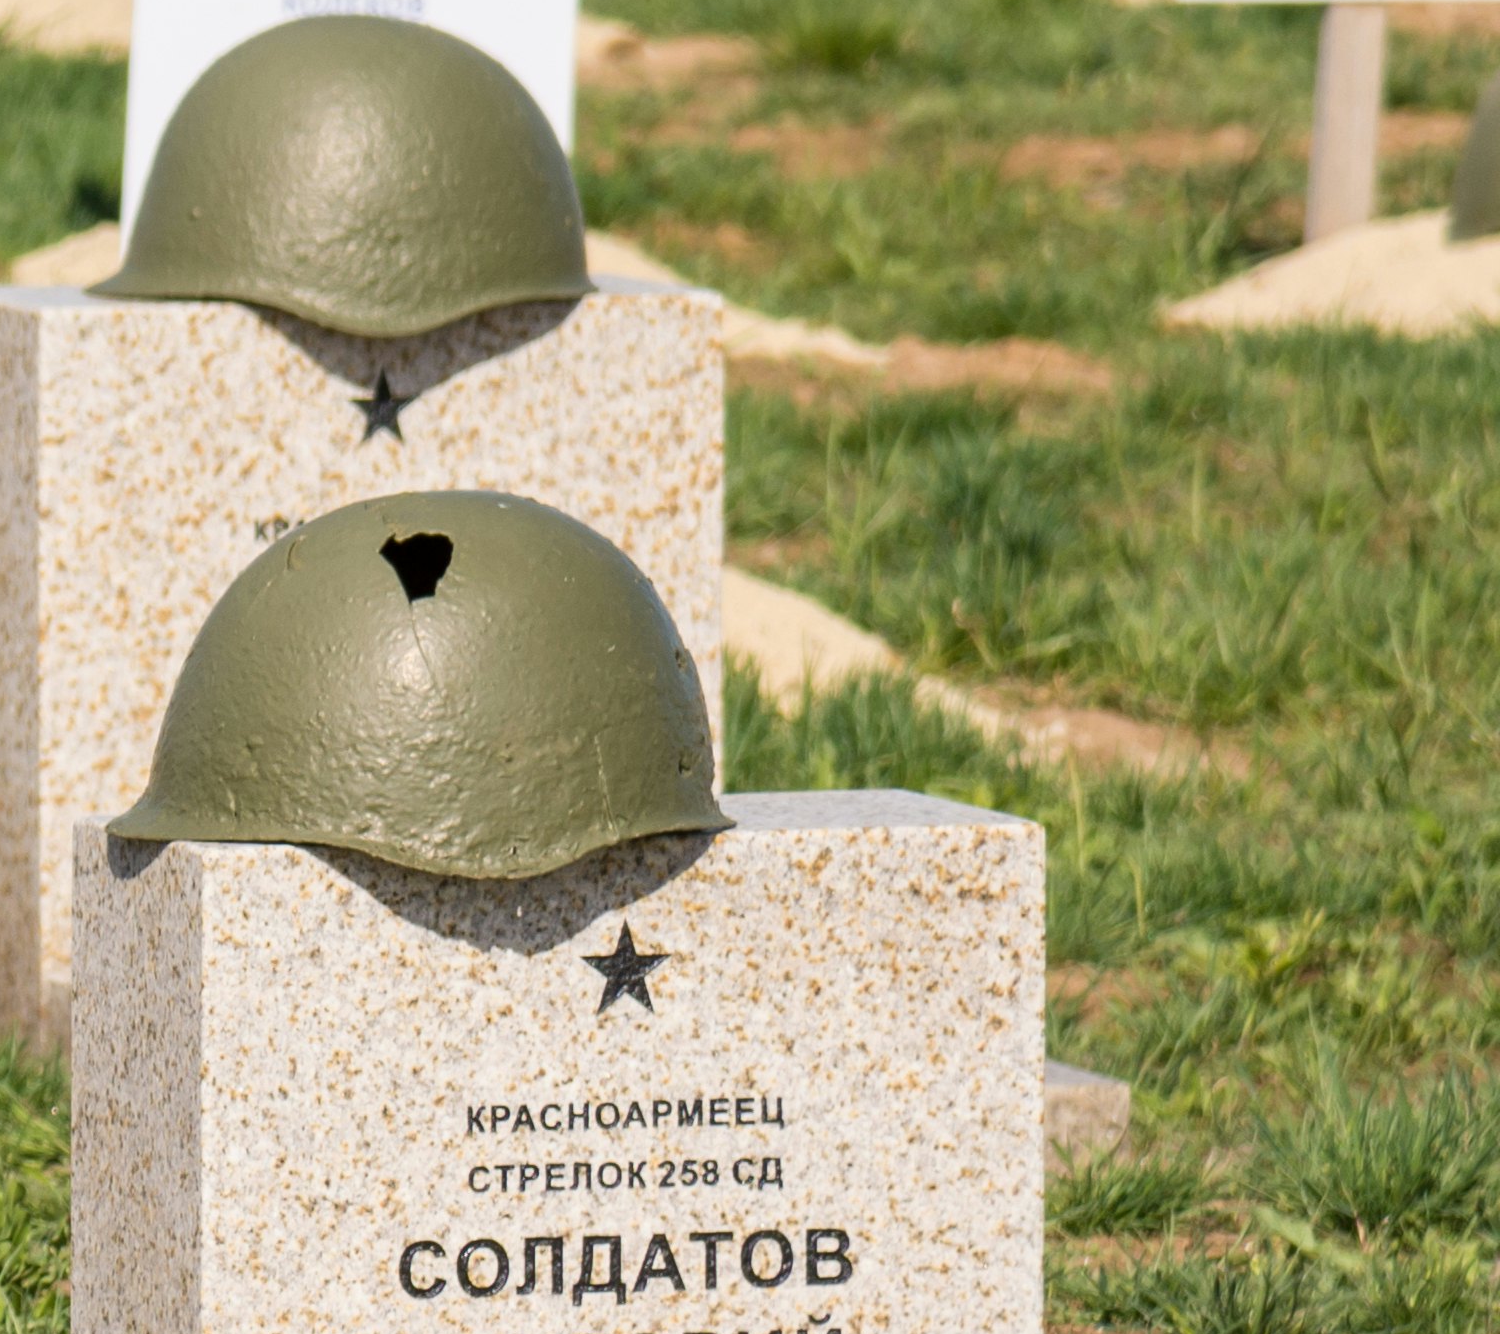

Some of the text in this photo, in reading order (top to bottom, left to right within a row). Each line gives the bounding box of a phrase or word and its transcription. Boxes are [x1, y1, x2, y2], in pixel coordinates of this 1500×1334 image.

[466, 1097, 786, 1133] КРАСНОАРМЕЕЦ
[468, 1156, 784, 1193] СТРЕЛОК 258 СД
[399, 1228, 854, 1305] СОЛДАТОВ
